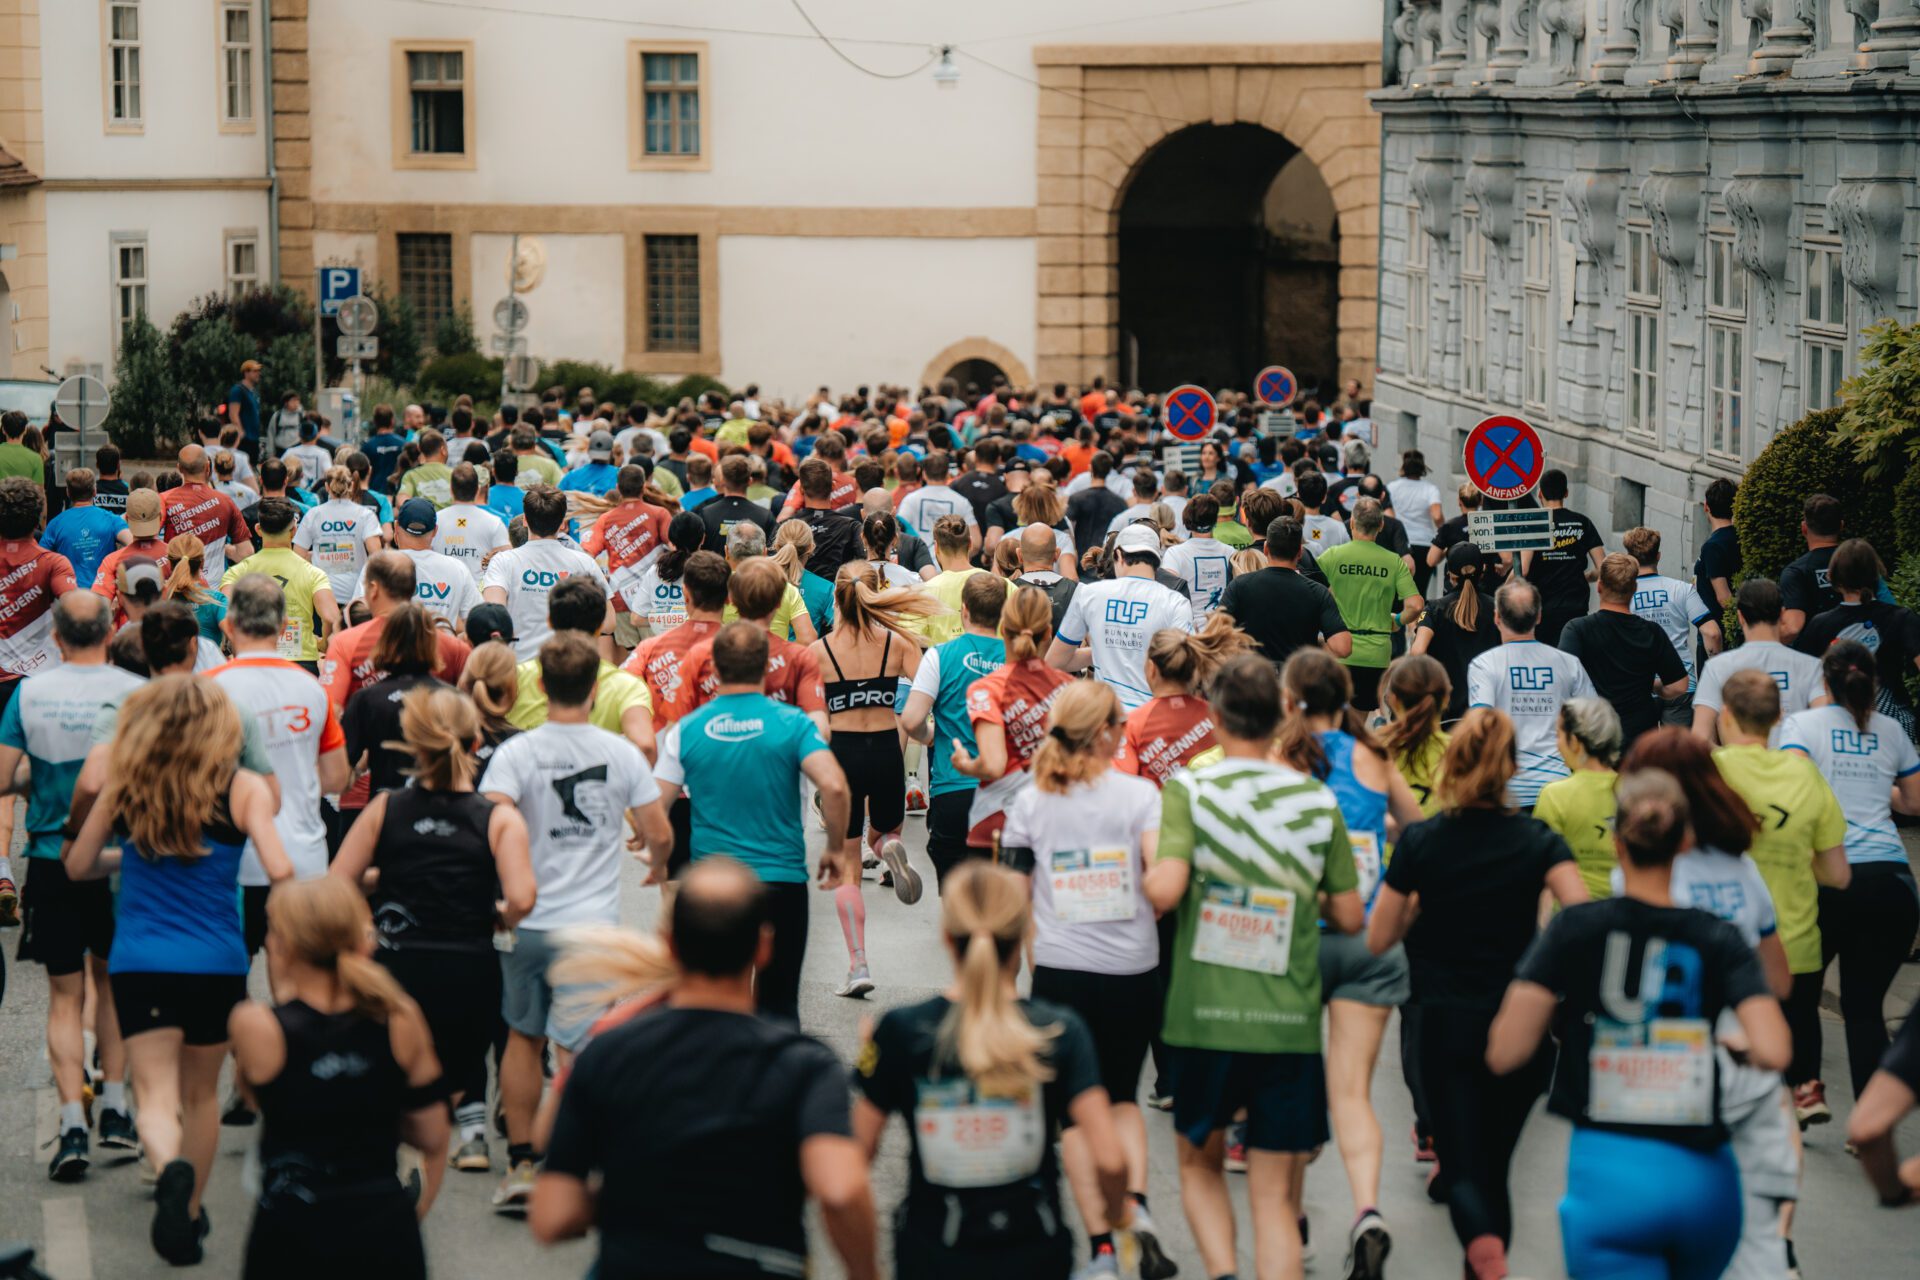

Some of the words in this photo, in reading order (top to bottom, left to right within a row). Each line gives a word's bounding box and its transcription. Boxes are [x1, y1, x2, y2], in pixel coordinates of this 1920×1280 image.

[329, 269, 351, 298] P
[1486, 484, 1528, 499] ANFANG
[167, 502, 186, 516] WIR
[174, 519, 195, 534] FÜR
[444, 545, 480, 558] LÄUFT,
[1339, 563, 1389, 578] GERALD
[415, 582, 451, 599] BV
[656, 614, 684, 625] 4109B
[647, 650, 677, 673] WIR
[849, 690, 896, 708] PRO
[1002, 698, 1029, 724] WIR
[1014, 722, 1045, 749] FÜR
[1139, 736, 1168, 764] WIR
